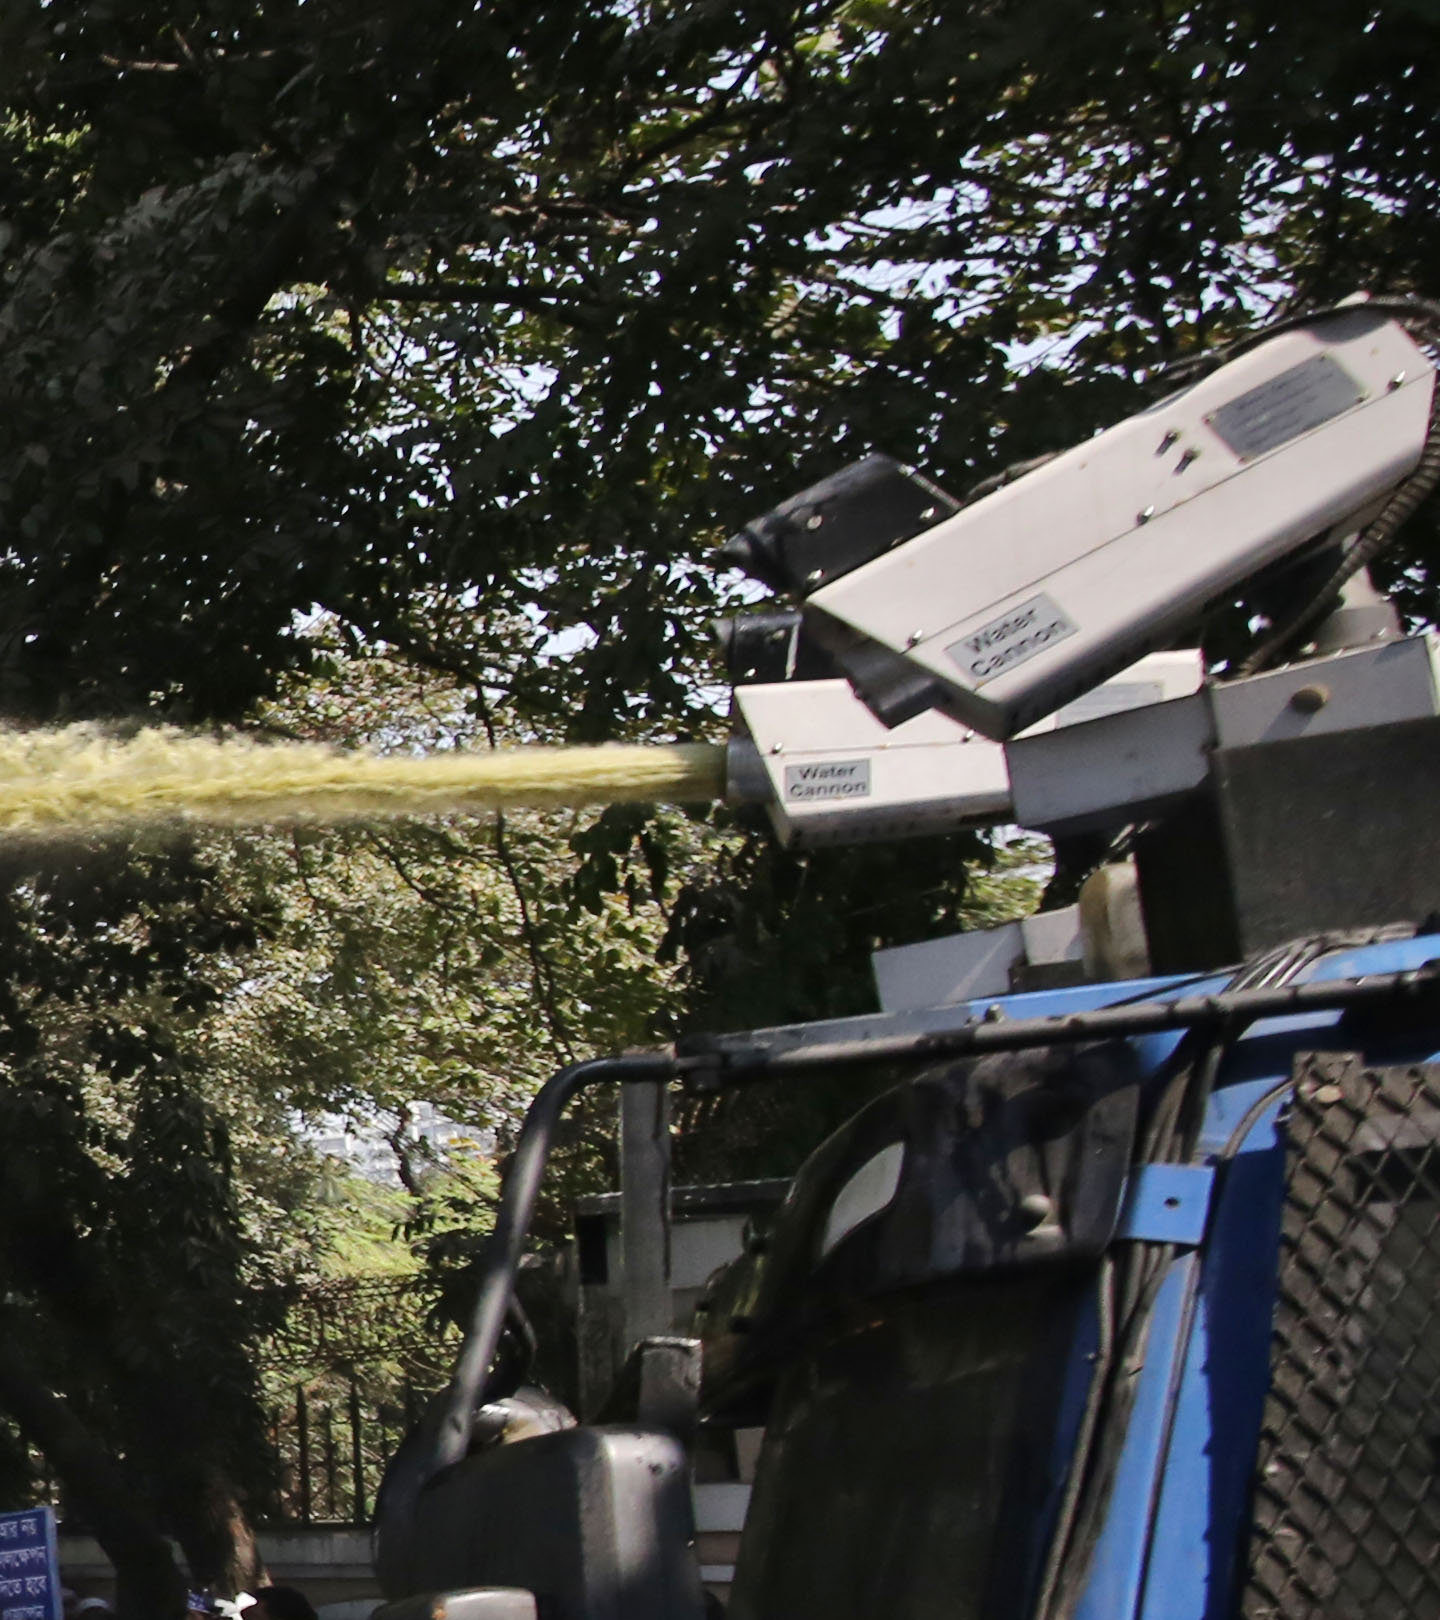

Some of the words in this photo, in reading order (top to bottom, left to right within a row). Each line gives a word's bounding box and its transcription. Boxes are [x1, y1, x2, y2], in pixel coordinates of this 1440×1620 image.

[965, 608, 1036, 653] Water
[970, 620, 1067, 676] Cannon
[799, 766, 857, 780] Water
[790, 783, 866, 797] Cannon
